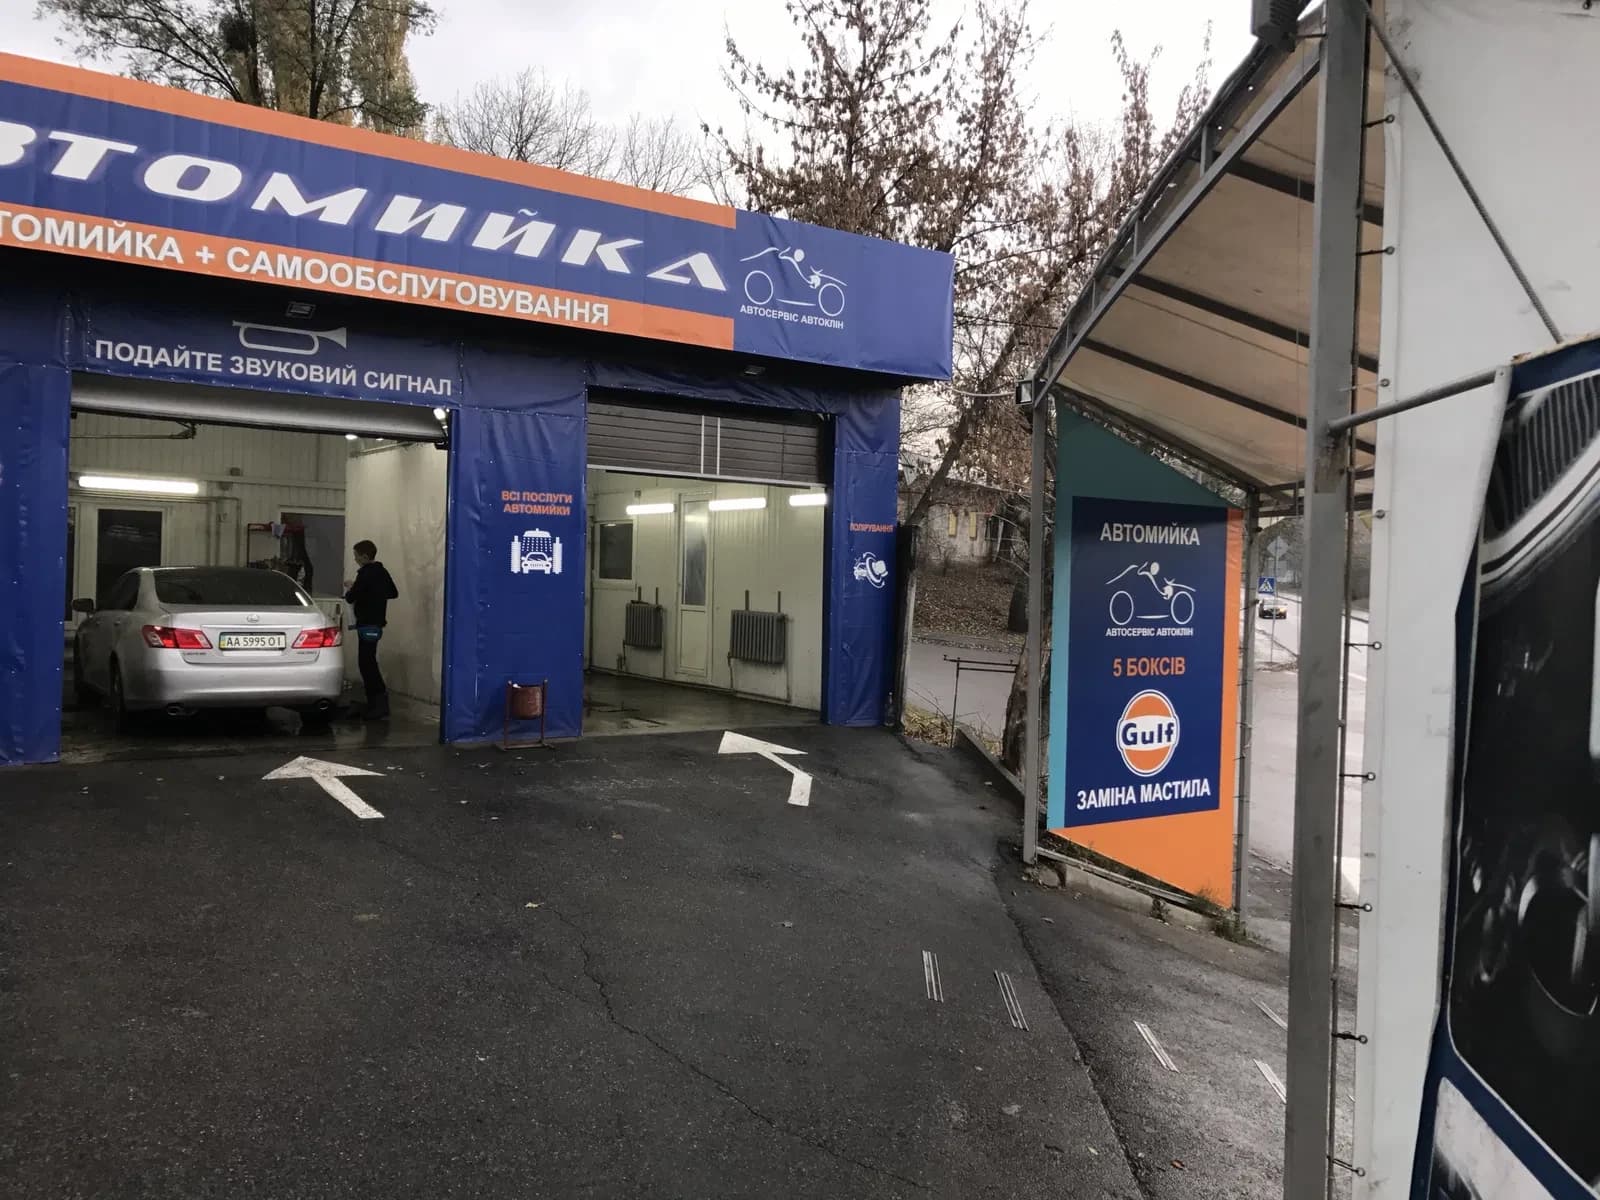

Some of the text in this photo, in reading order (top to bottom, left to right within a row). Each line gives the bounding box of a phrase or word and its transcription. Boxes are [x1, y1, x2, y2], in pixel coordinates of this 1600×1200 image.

[227, 246, 609, 326] САМООБСЛУГОВУВАННЯ
[740, 304, 844, 329] АВТОСЕРВІС АВТОКЛІН
[95, 340, 453, 396] ПОДАЙТЕ ЗВУКОВИЙ СИГНАЛ
[501, 491, 573, 504] ВСІ ПОСЛУГИ
[503, 503, 571, 516] АВТОМИЙКИ
[1100, 522, 1200, 546] АВТОМИЙКА
[226, 637, 240, 647] AA
[243, 637, 266, 647] 5995
[1105, 627, 1194, 637] АВТОСЕРВІС АВТОКЛІН
[1113, 657, 1186, 677] 5 БОКСІВ
[1121, 722, 1175, 746] Gulf
[1076, 778, 1212, 810] ЗАМІНА МАСТИЛА
